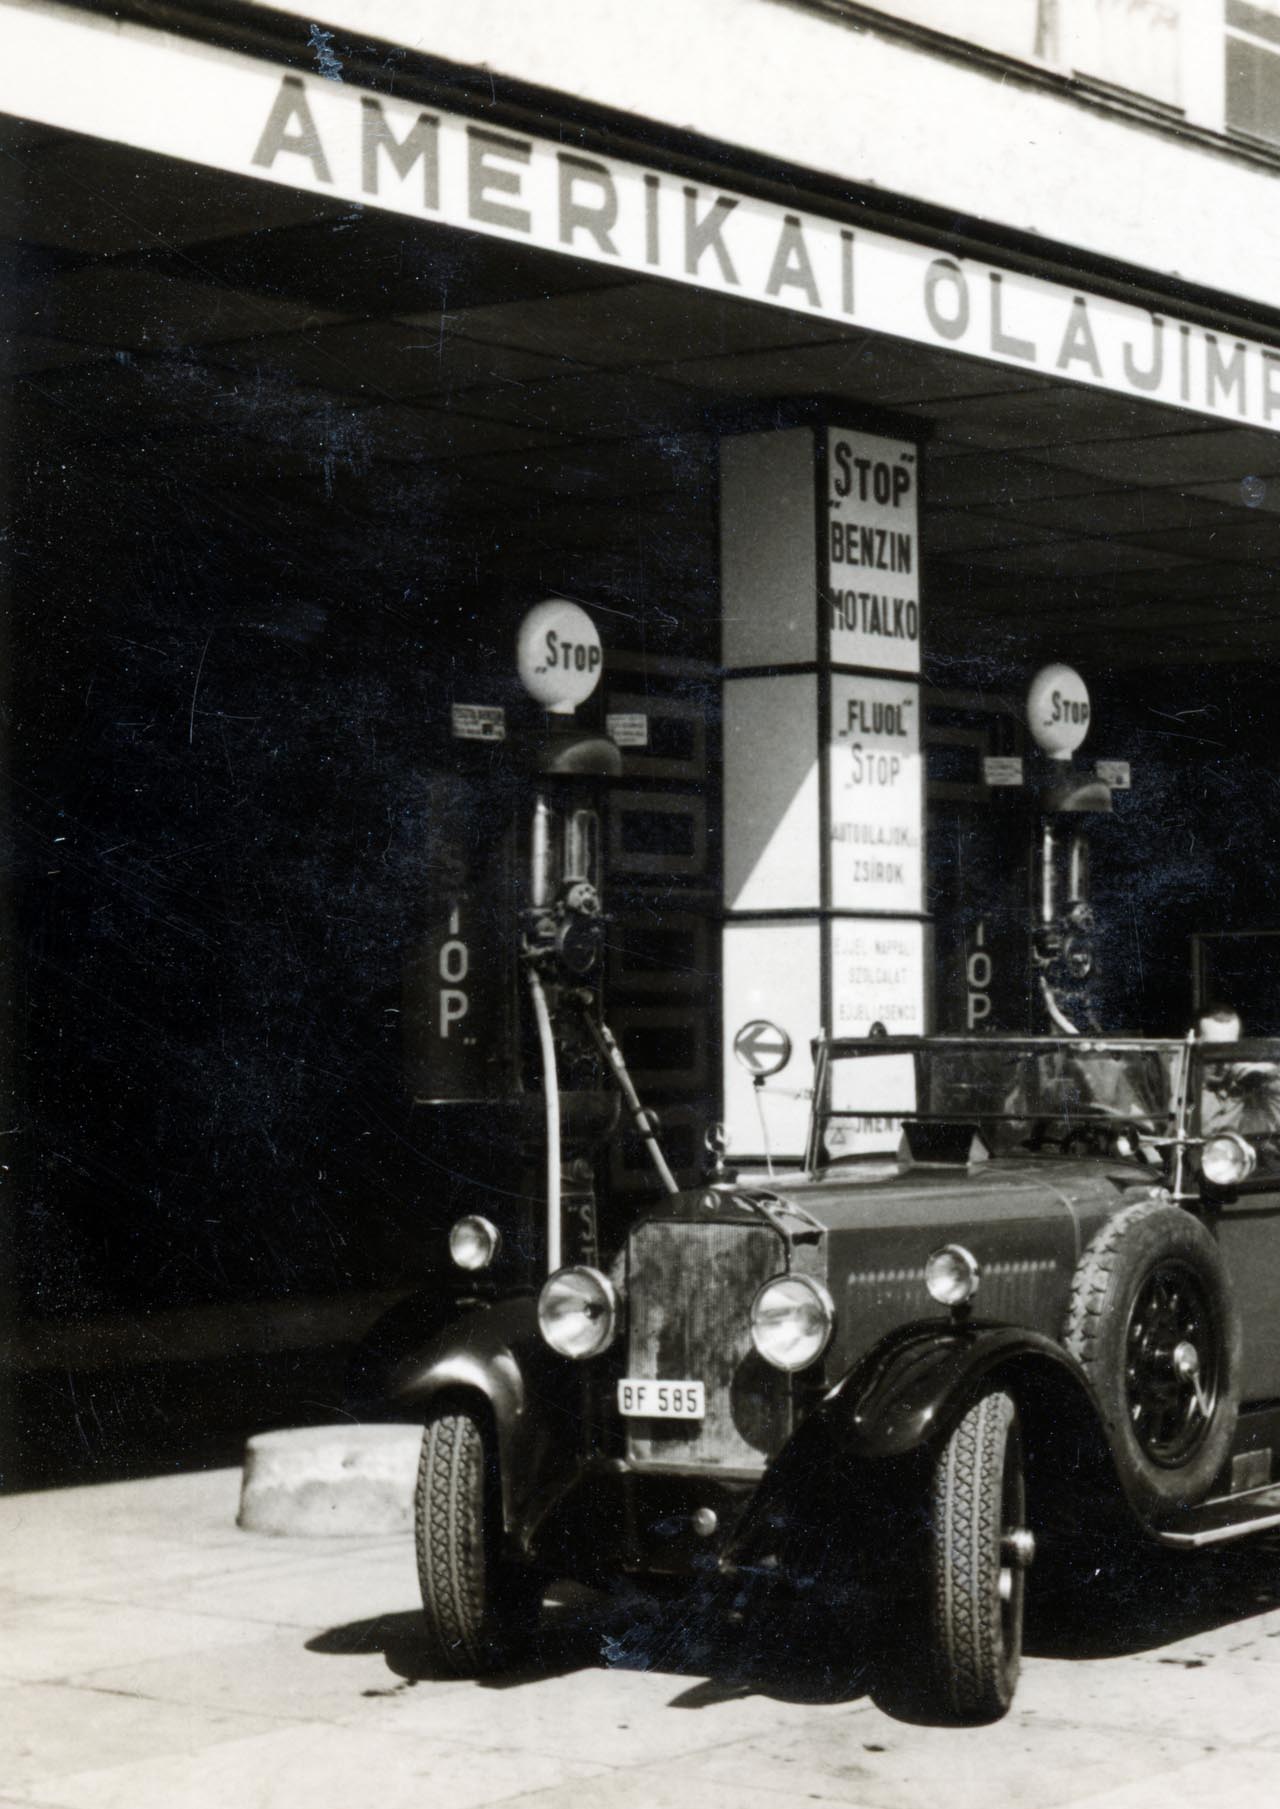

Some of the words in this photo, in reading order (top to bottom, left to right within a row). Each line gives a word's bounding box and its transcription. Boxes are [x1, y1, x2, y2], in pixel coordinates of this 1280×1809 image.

[251, 74, 854, 315] AMERIKAI
[830, 521, 911, 575] BENZIN
[830, 587, 918, 641] MOTALKO
[624, 1386, 647, 1411] BF
[658, 1387, 698, 1413] 585
